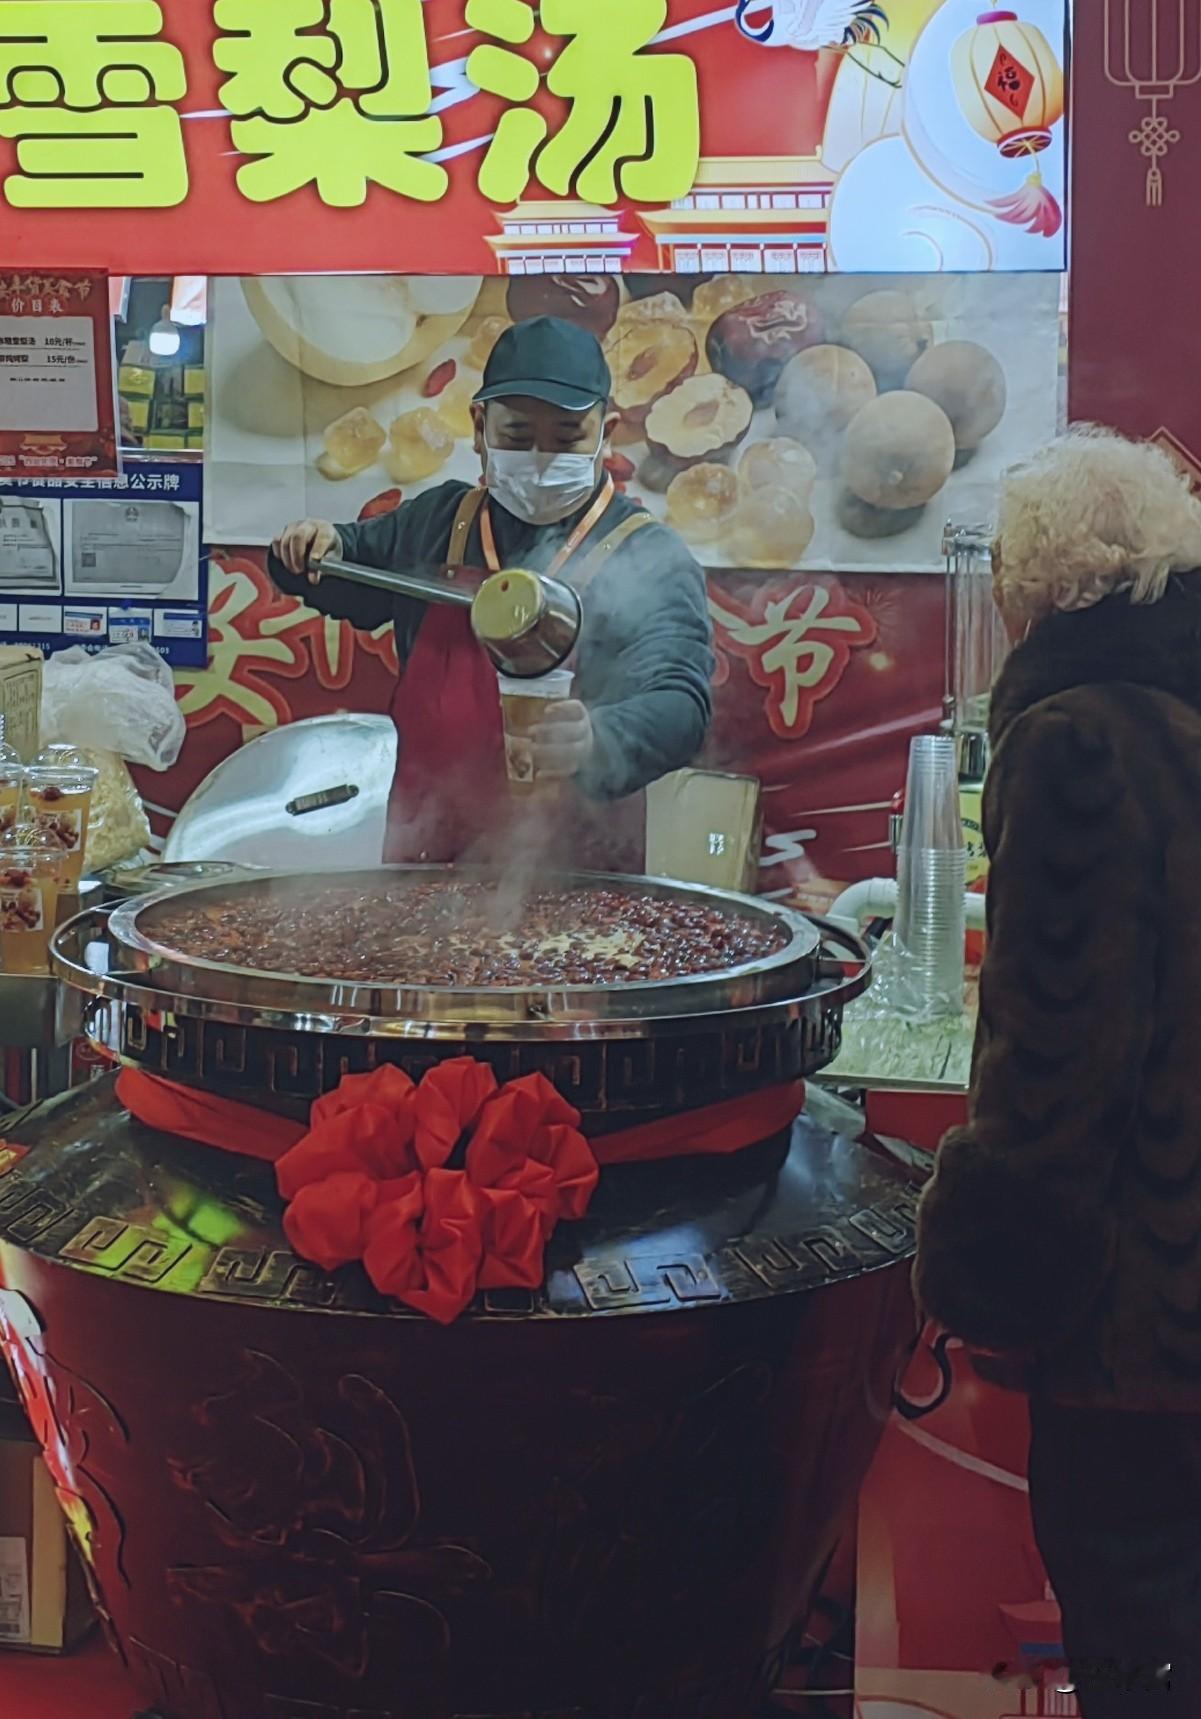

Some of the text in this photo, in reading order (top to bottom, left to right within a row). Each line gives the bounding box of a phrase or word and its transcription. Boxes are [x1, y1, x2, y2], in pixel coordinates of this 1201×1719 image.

[0, 0, 700, 207] 雪梨汤
[12, 298, 64, 312] 价目表
